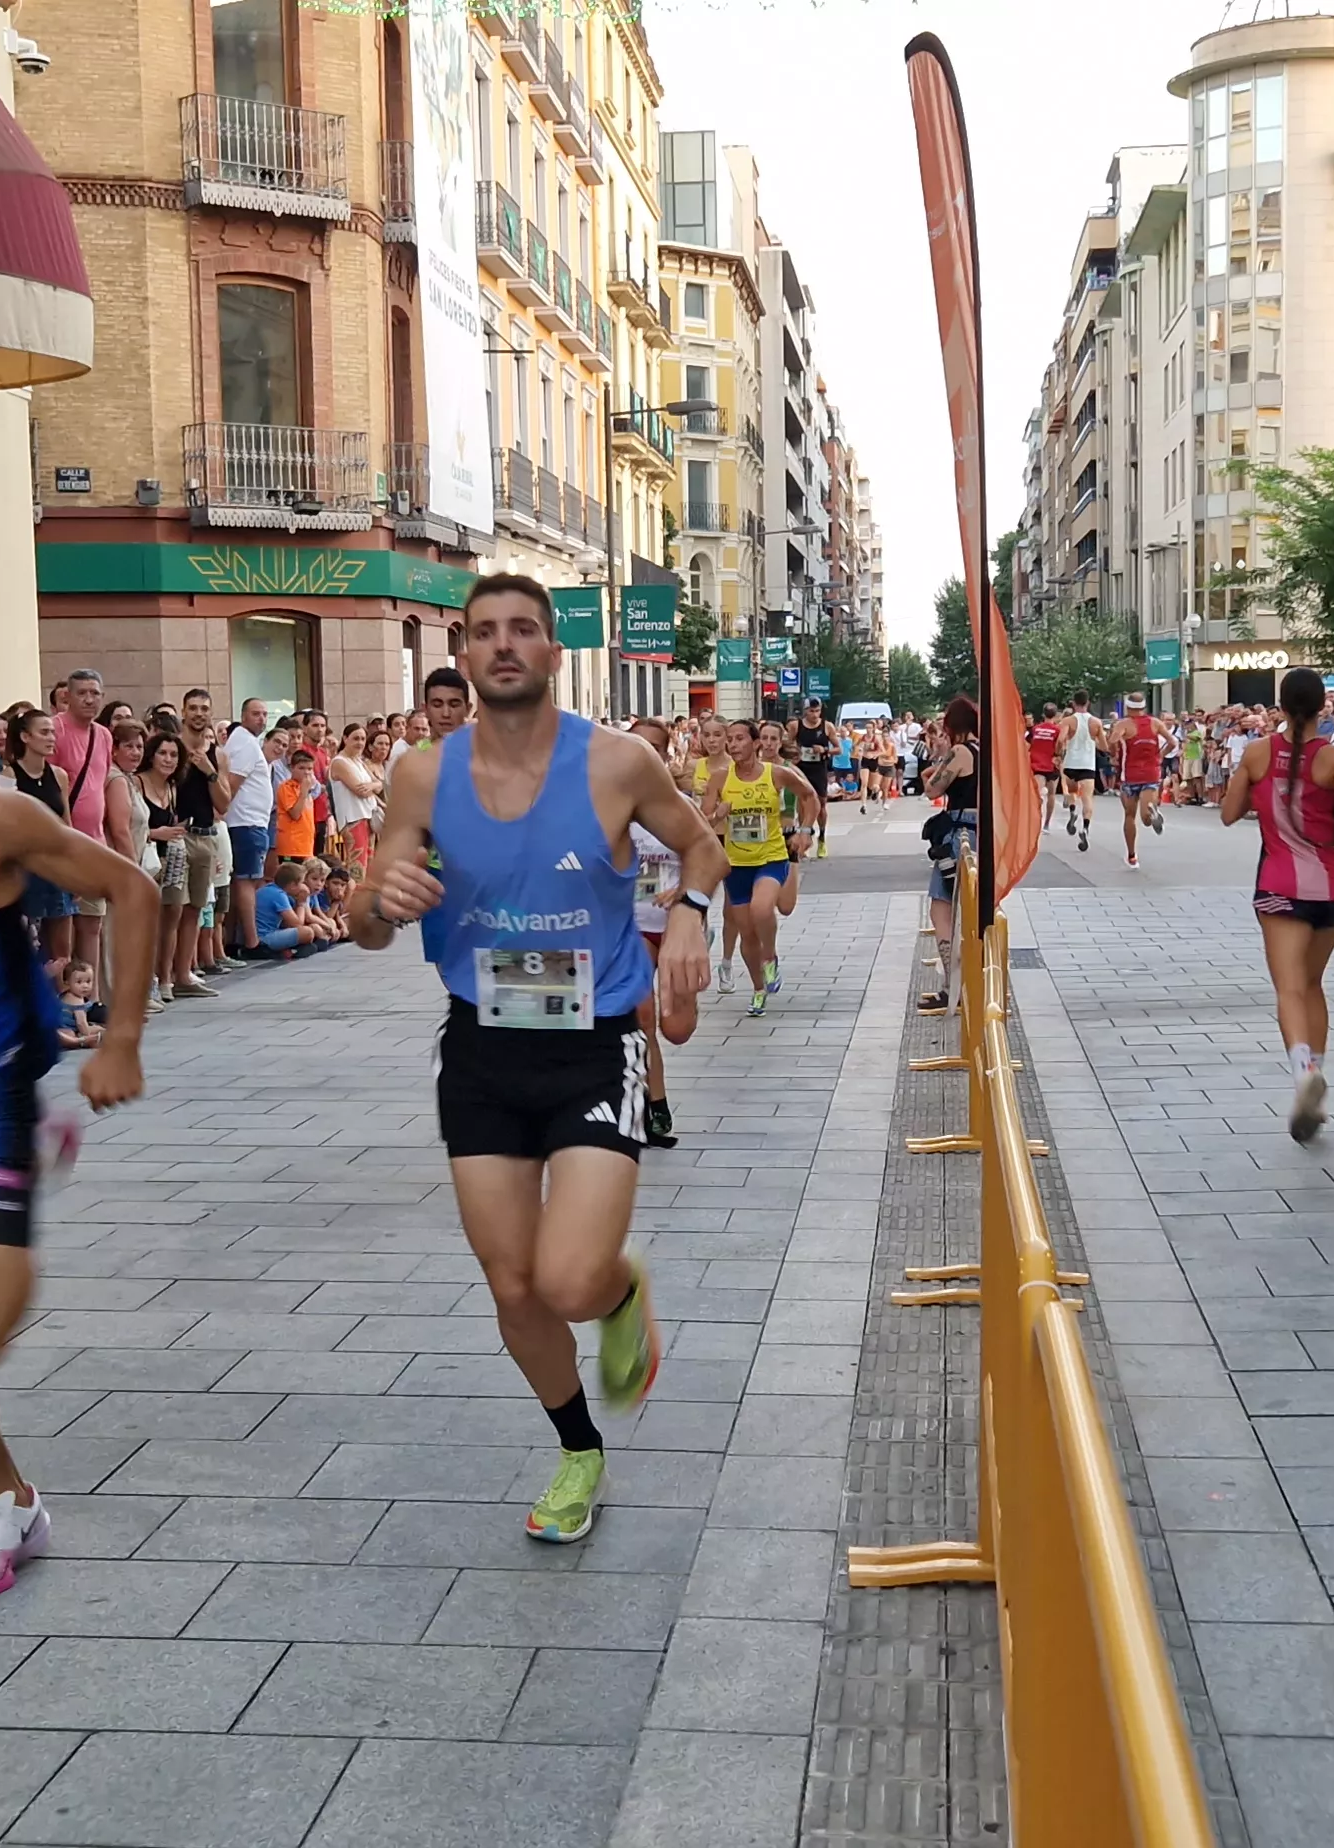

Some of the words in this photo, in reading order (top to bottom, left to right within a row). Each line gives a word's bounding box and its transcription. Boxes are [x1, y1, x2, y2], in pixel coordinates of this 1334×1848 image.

[444, 291, 478, 338] LORENZO
[627, 598, 647, 608] vive
[627, 608, 648, 619] San
[627, 620, 671, 631] Lorenzo
[1213, 650, 1290, 671] MANGO
[740, 815, 754, 826] 17
[523, 952, 546, 976] 8
